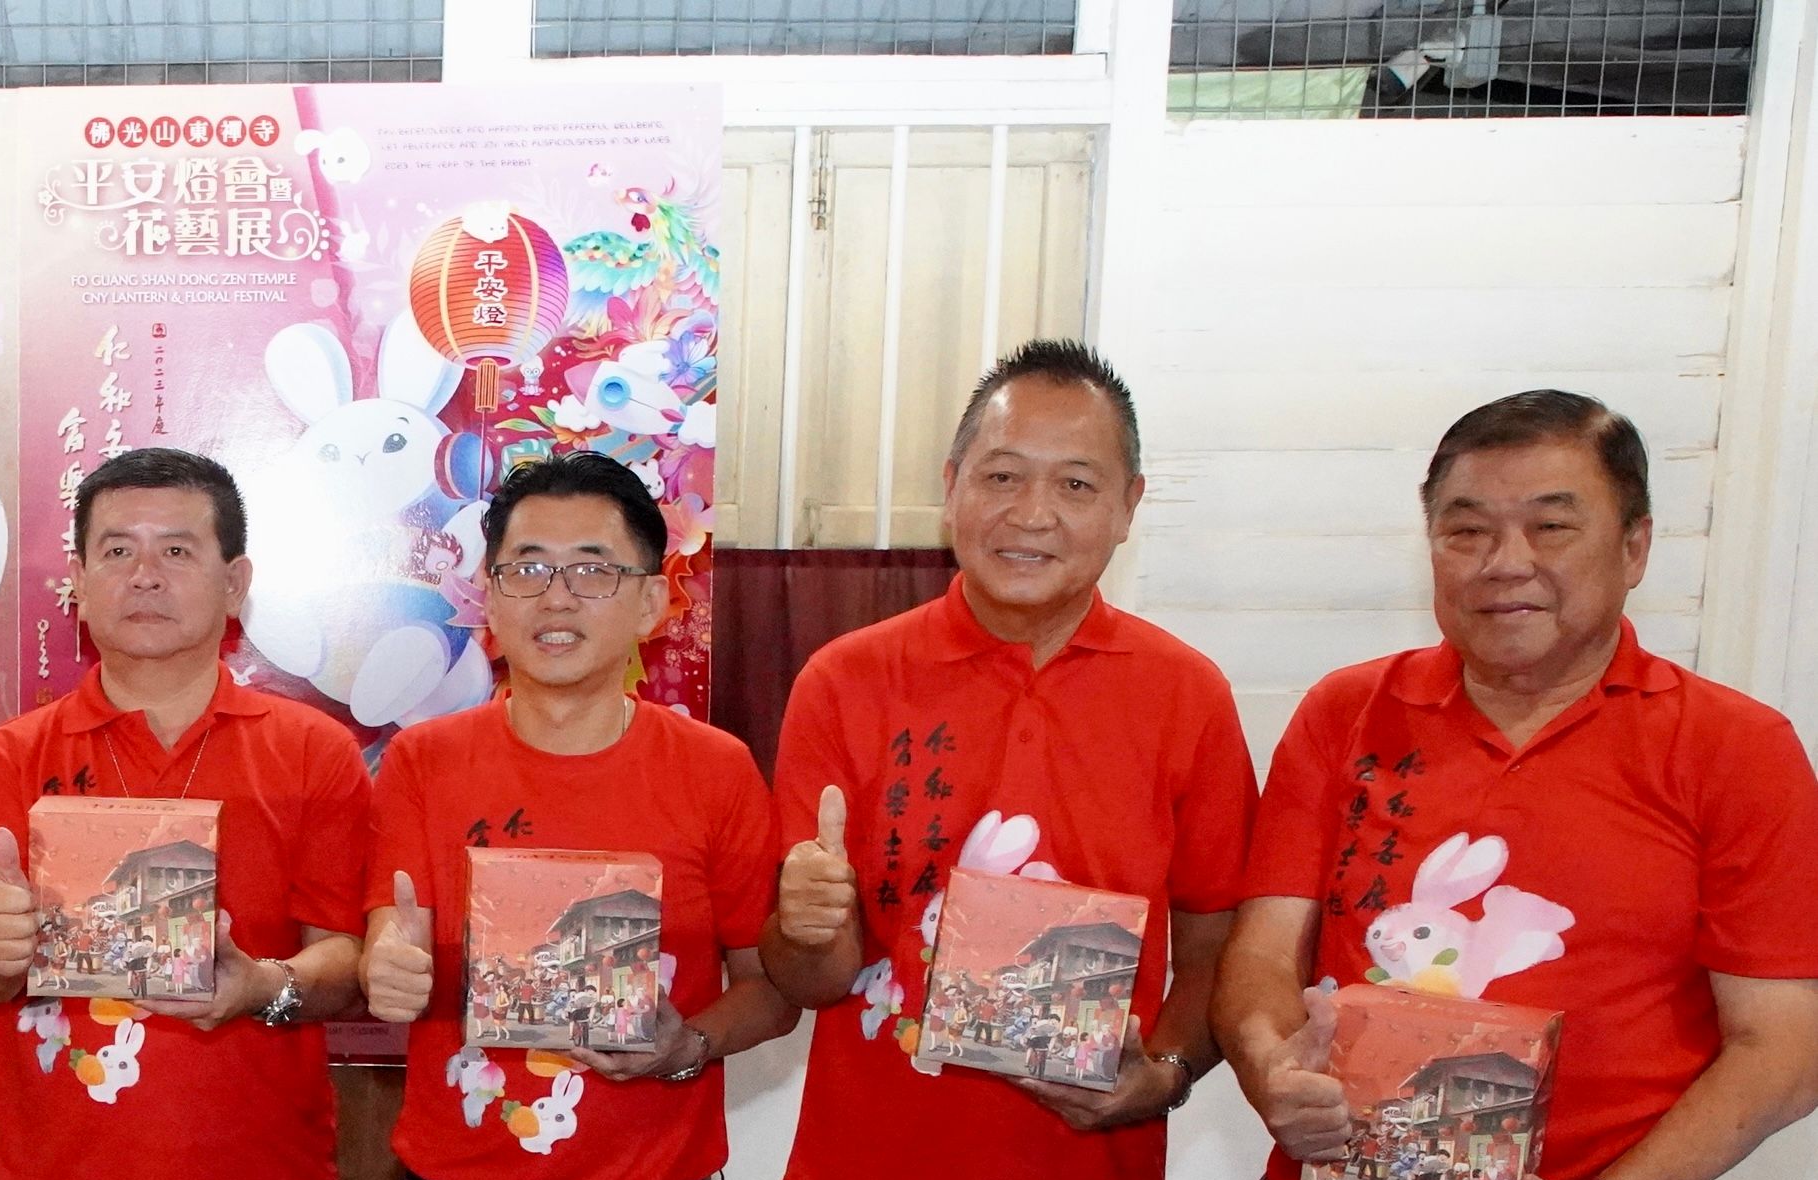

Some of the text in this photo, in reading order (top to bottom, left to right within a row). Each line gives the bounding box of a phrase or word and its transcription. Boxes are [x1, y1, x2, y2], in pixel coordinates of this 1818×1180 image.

[88, 118, 277, 147] 佛光山東禪寺
[121, 207, 274, 257] 花藝展
[71, 272, 297, 288] FO GUANG SHAN DONG ZEN TEMPLE
[473, 250, 508, 326] 平安燈
[82, 290, 287, 304] CNY LANTERN & FLORAL FESTIVAL
